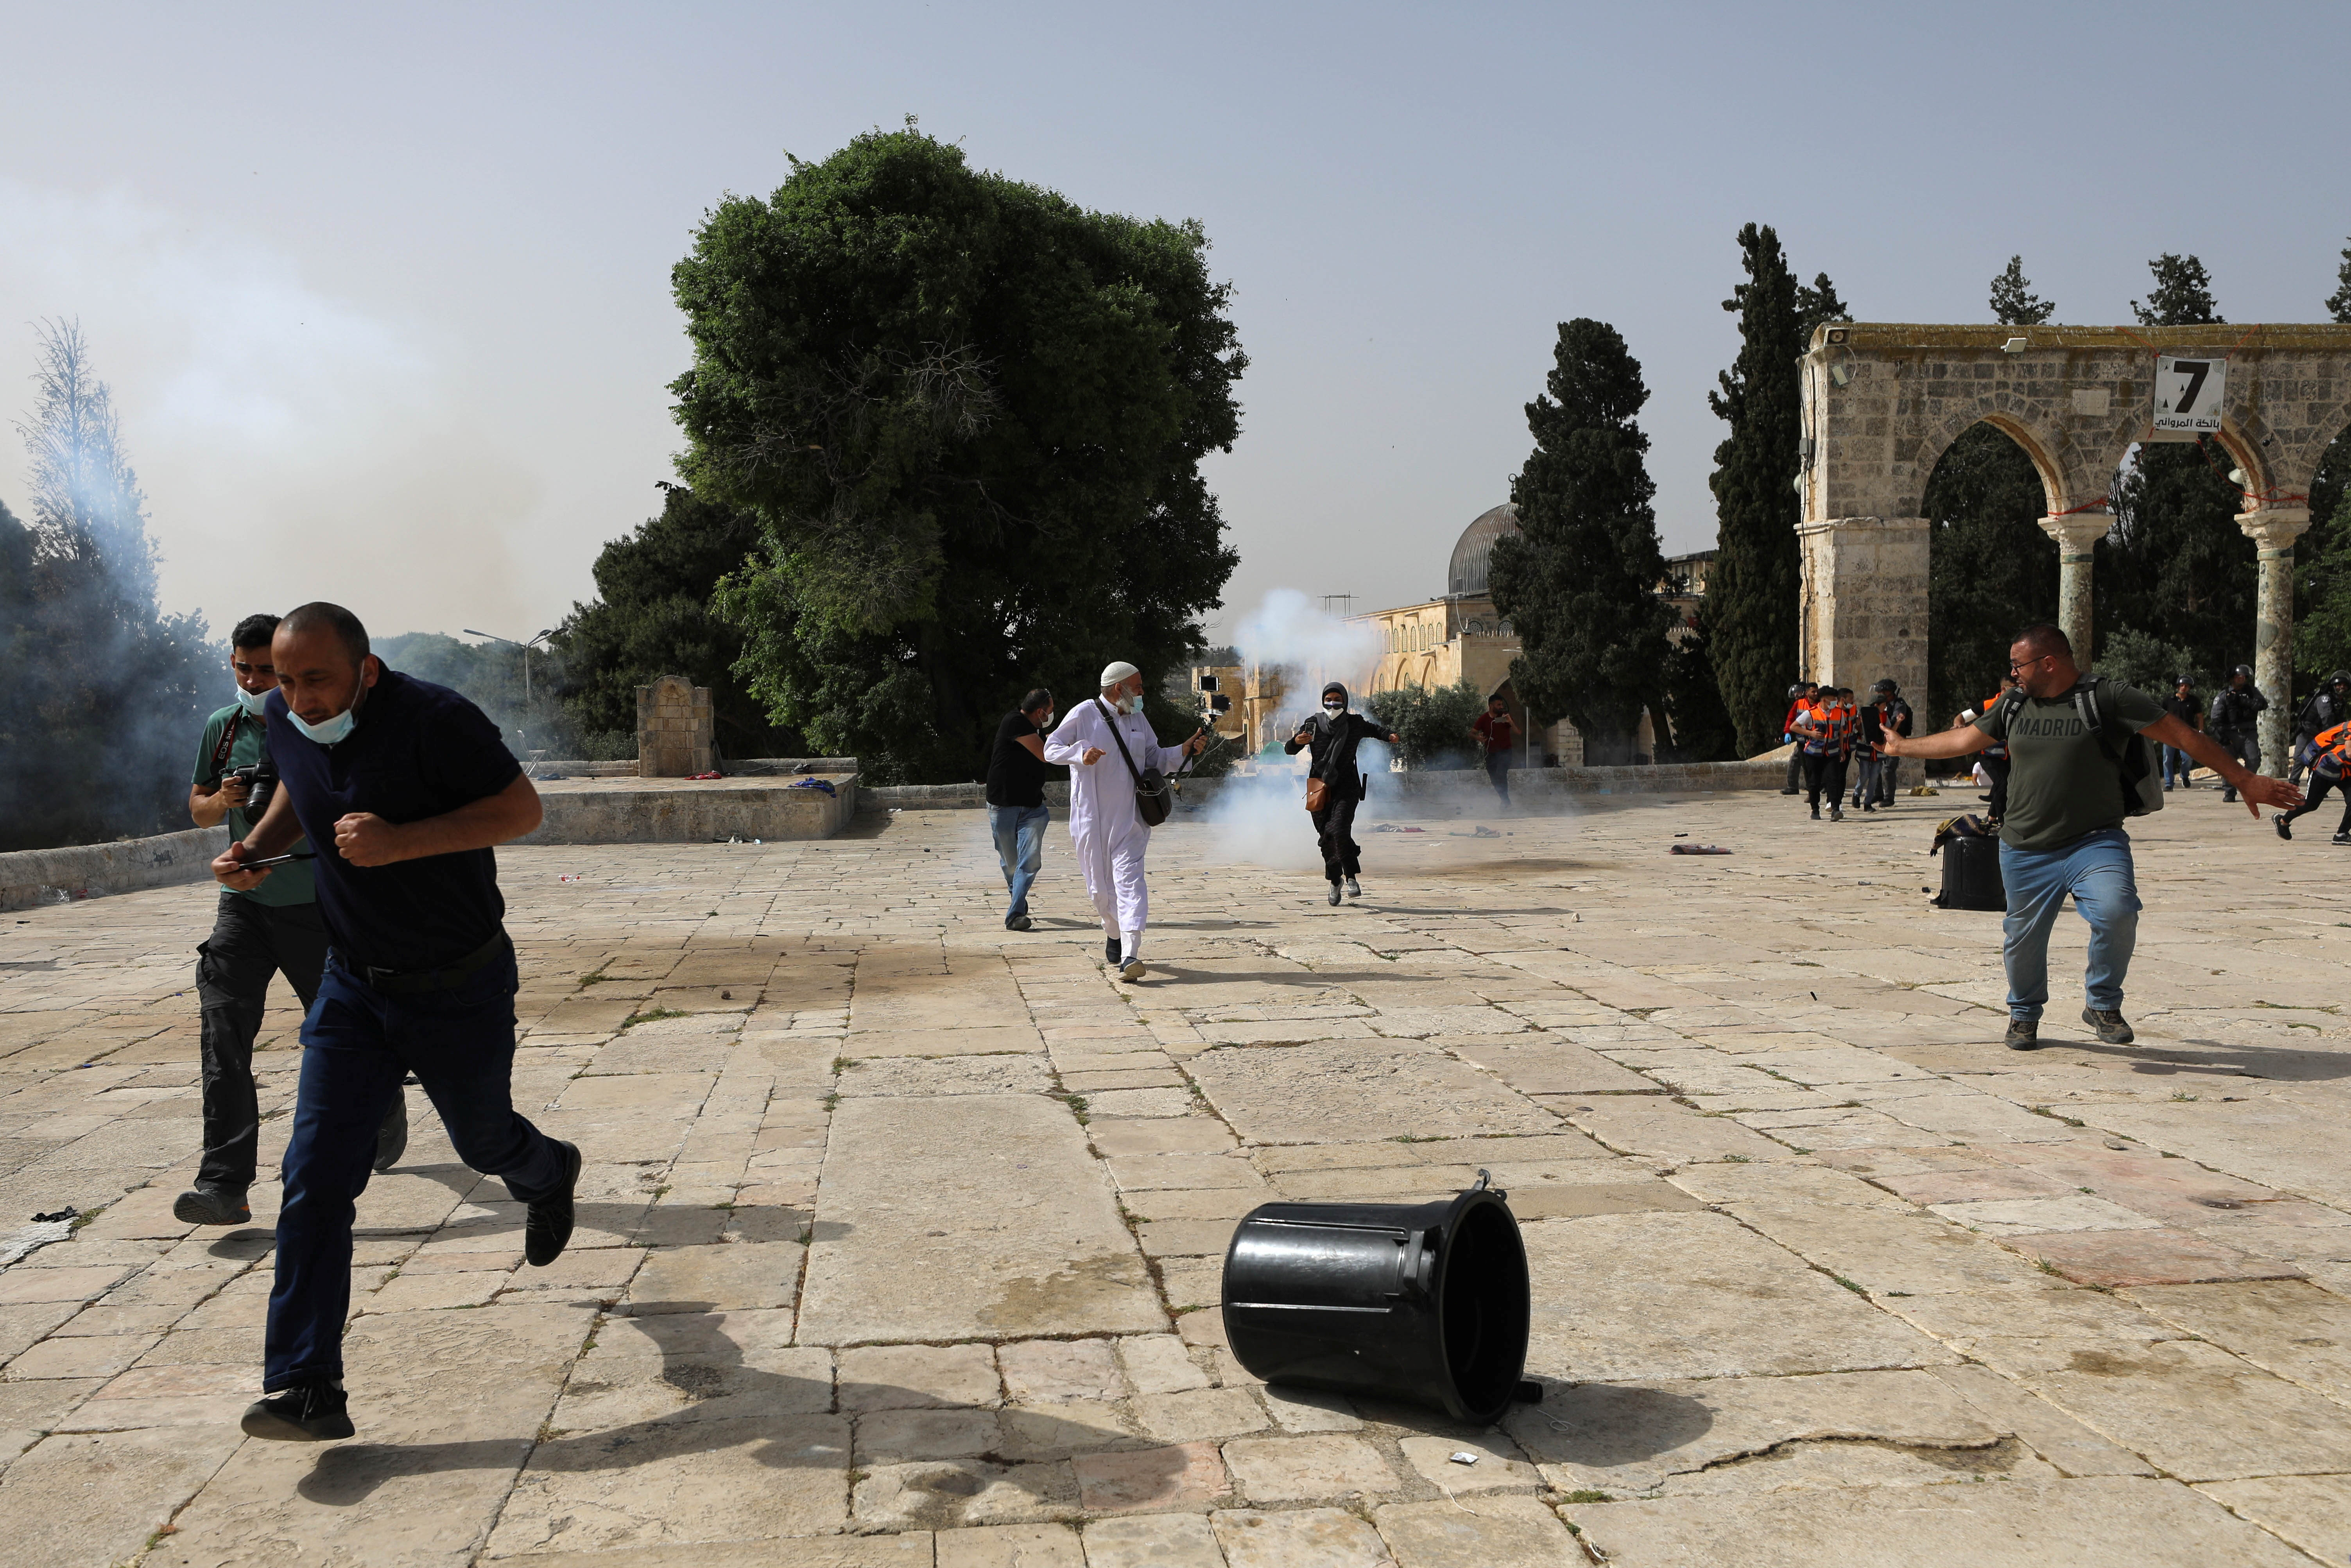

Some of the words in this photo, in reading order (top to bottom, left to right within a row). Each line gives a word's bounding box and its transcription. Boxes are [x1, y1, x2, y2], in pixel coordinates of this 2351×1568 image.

[2174, 361, 2210, 413] 7
[2155, 417, 2193, 428] المرواني
[2195, 419, 2220, 429] بائكة
[2016, 718, 2082, 736] MADRID
[218, 741, 229, 759] EOS
